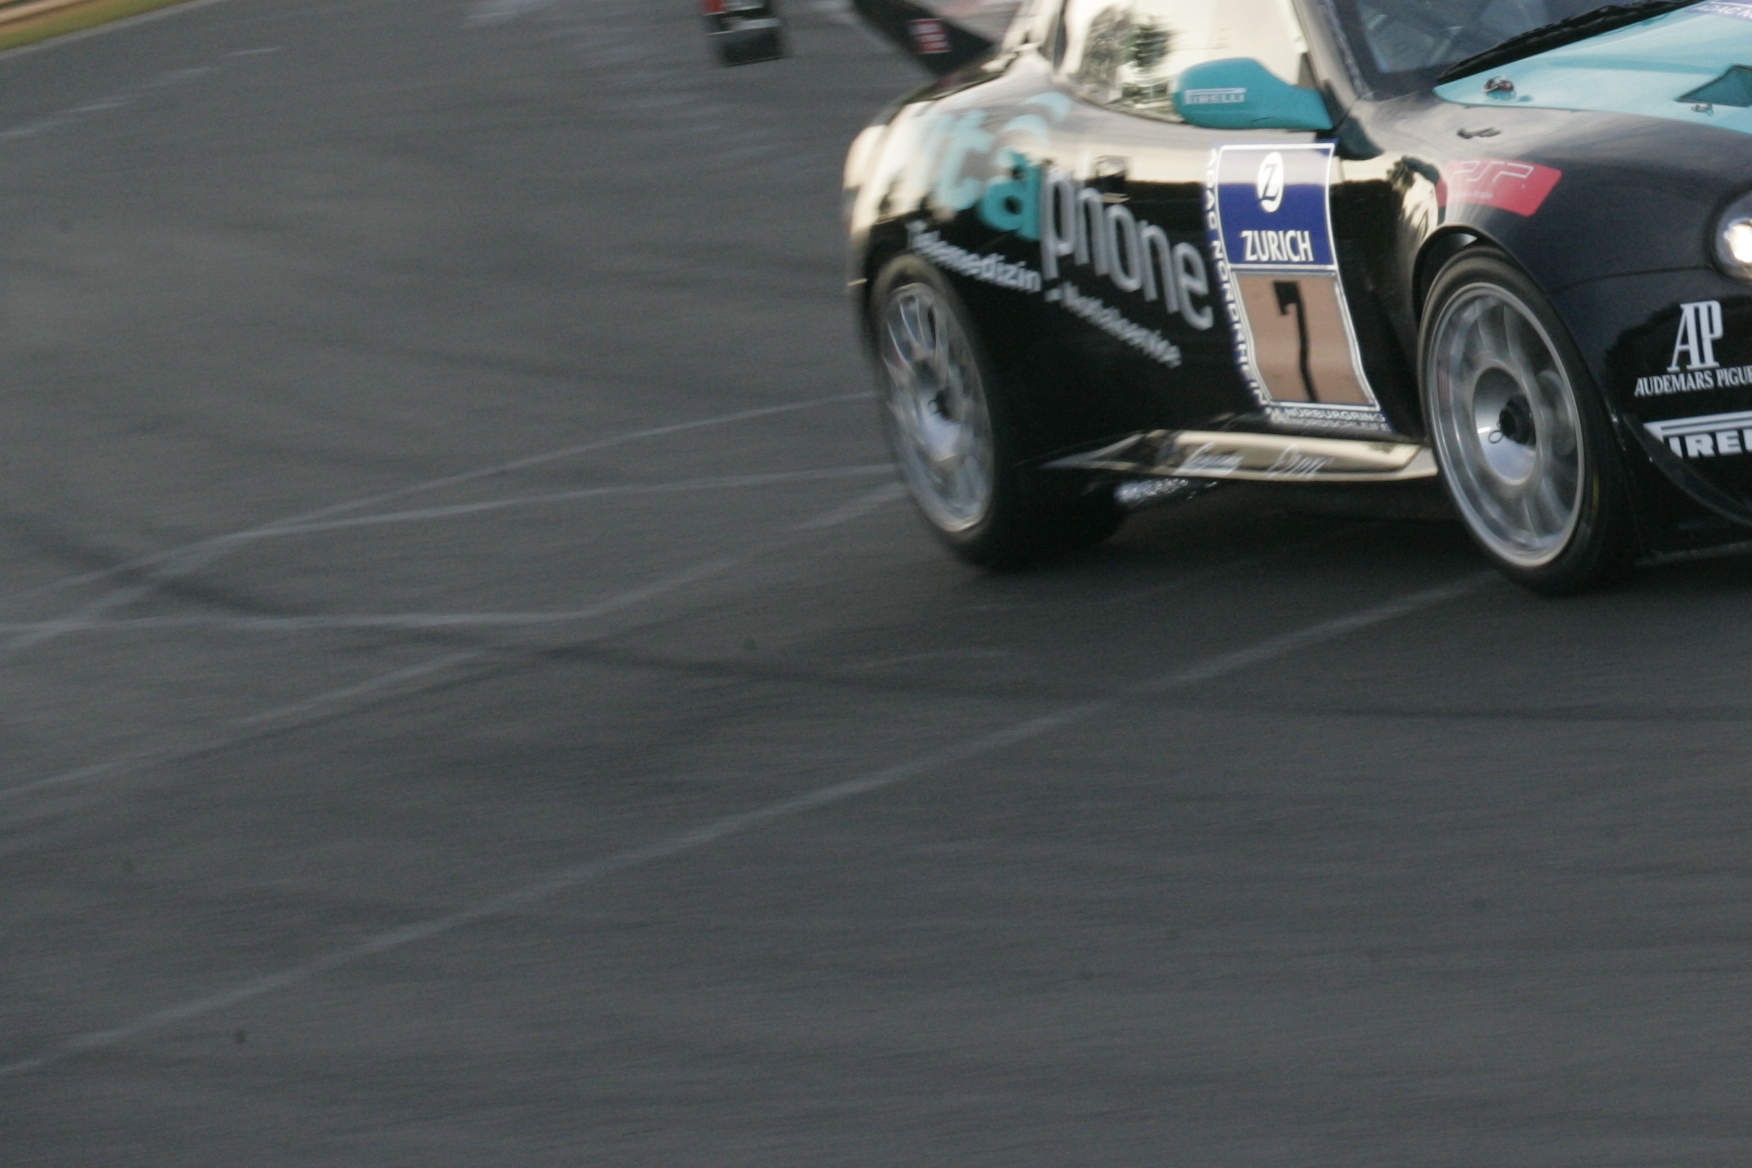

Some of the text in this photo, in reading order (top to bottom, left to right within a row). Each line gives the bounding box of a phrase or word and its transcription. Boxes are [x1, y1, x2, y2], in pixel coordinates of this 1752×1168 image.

[1184, 87, 1247, 105] PIRELLI
[1240, 229, 1315, 263] ZURICH
[1272, 280, 1320, 402] 7
[1667, 299, 1724, 373] AP
[1634, 371, 1714, 398] AUDEMARS
